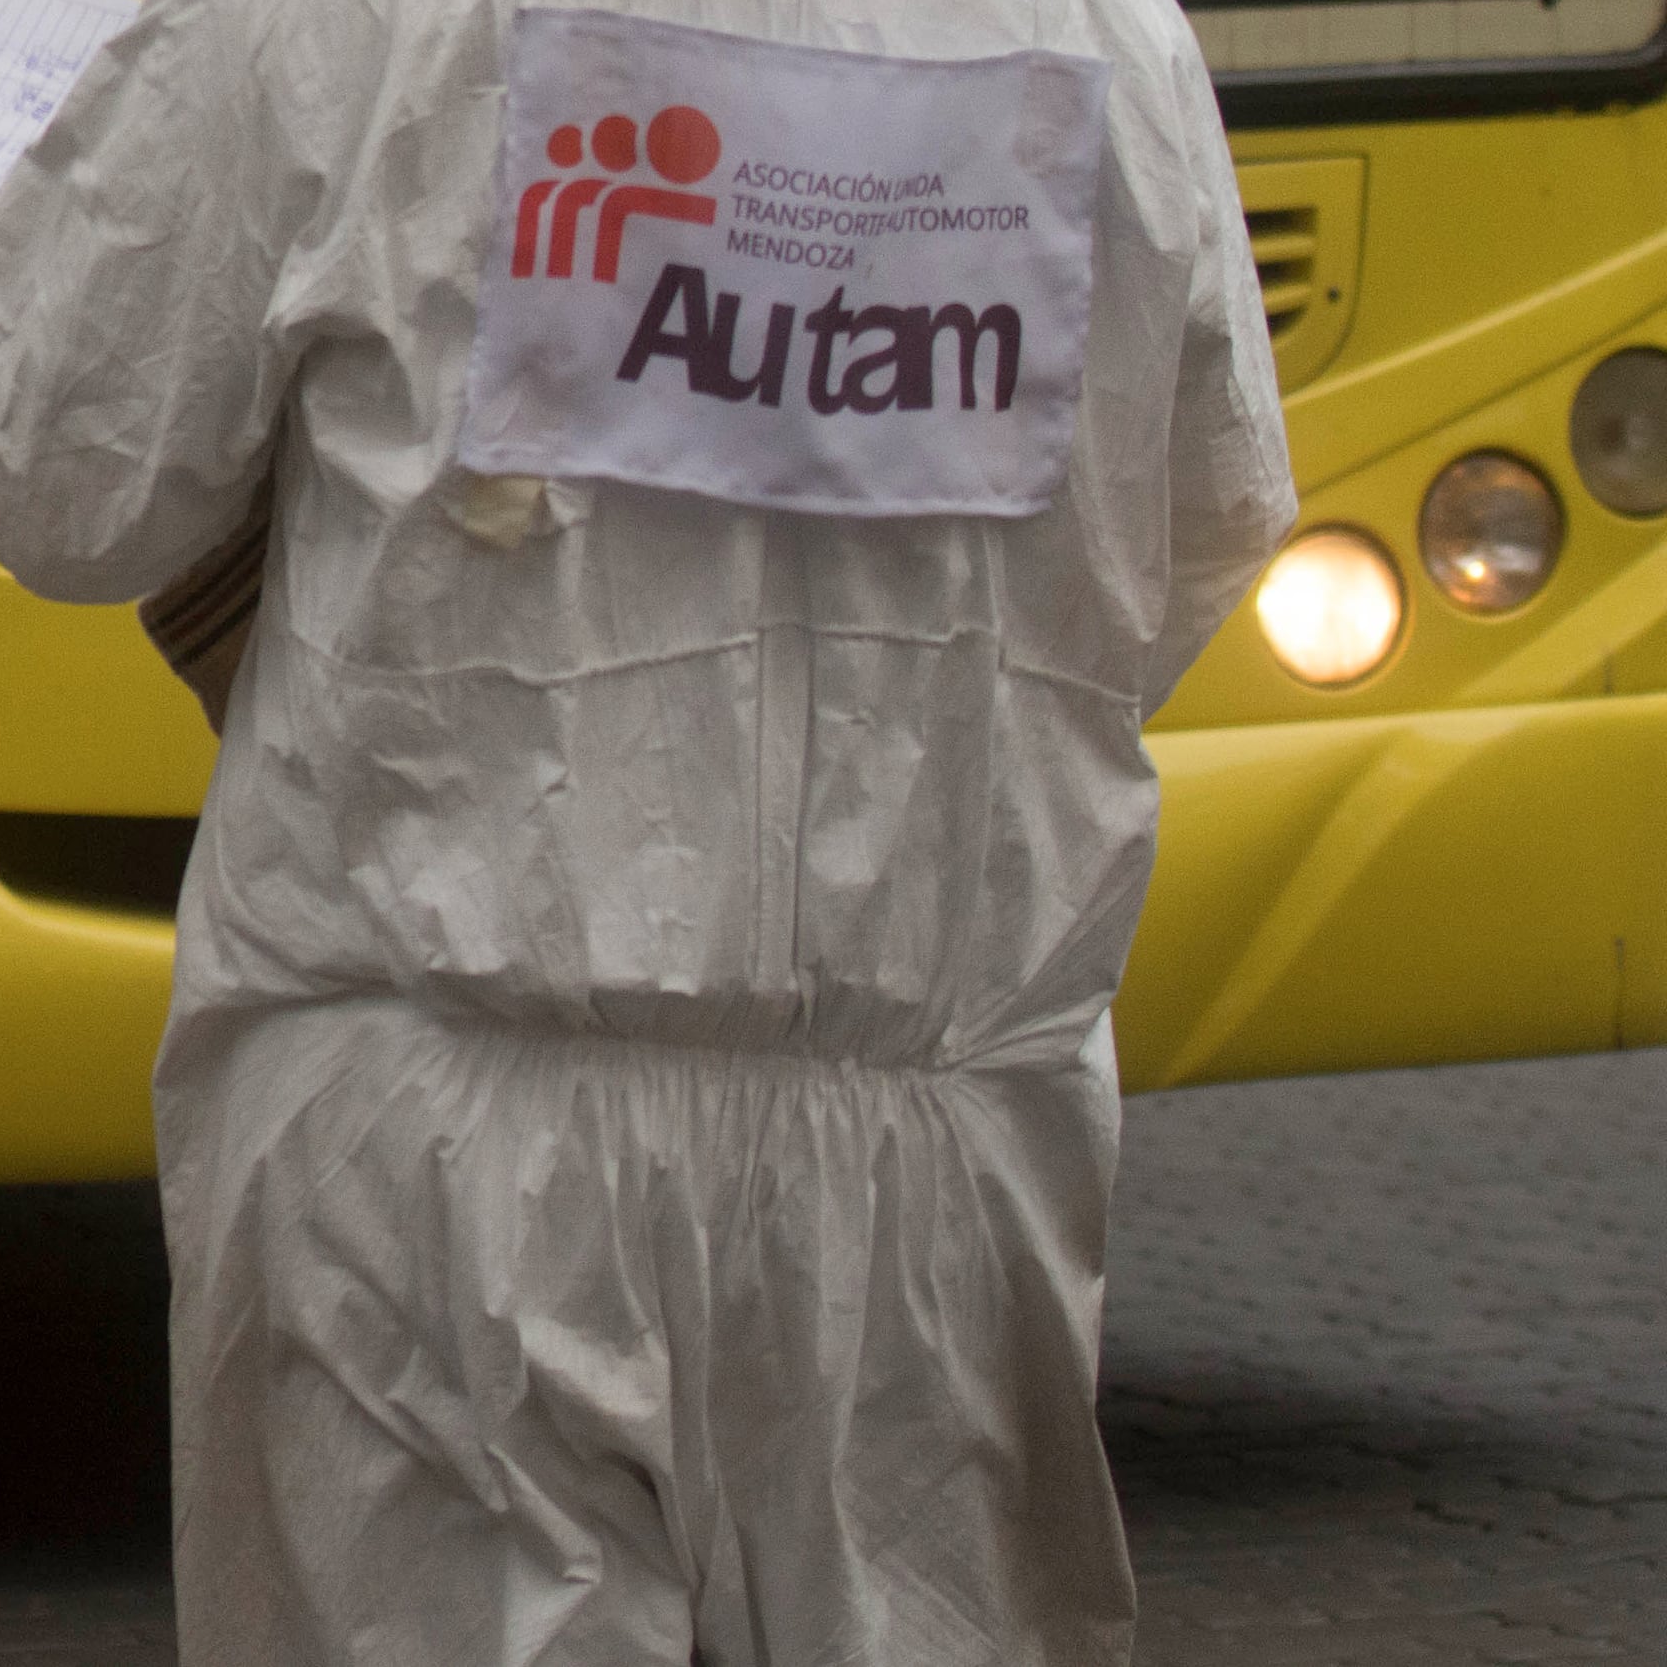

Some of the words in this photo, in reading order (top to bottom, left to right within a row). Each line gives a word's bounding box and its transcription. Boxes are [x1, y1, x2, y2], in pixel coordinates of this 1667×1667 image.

[733, 160, 890, 203] ASOCIACIÓN
[727, 229, 855, 270] MENDOZA
[616, 264, 1022, 416] Autam
